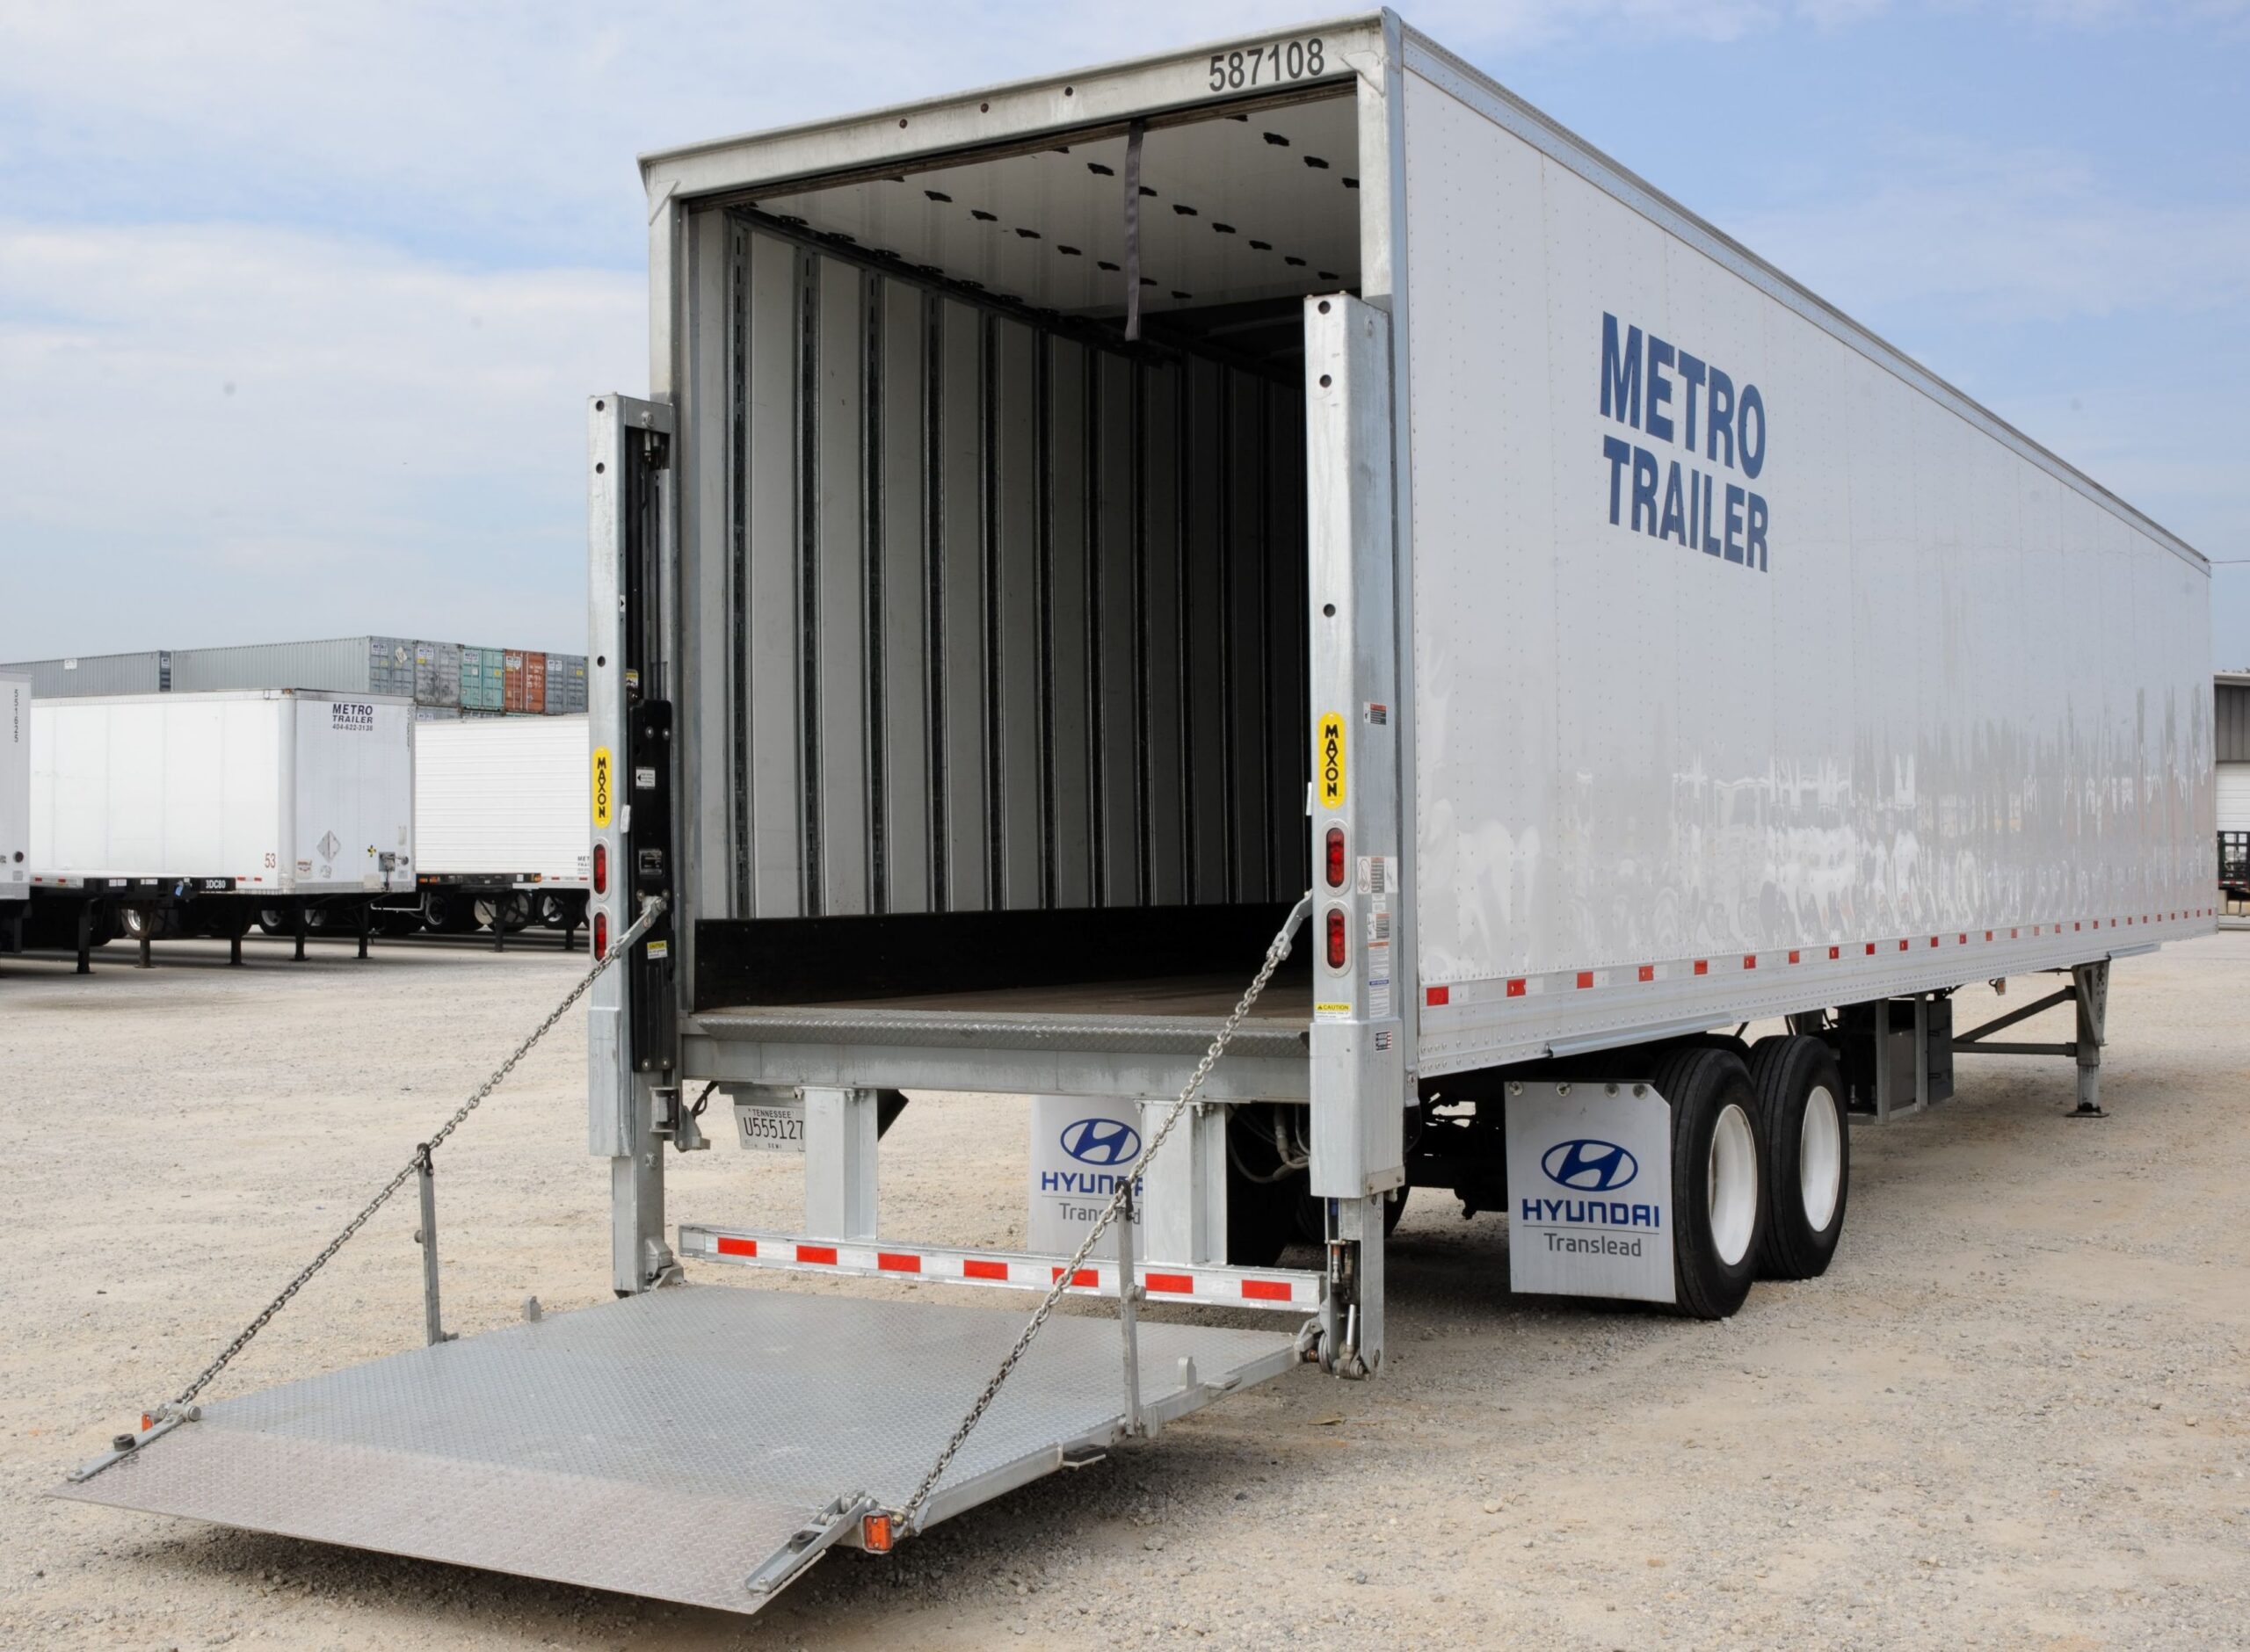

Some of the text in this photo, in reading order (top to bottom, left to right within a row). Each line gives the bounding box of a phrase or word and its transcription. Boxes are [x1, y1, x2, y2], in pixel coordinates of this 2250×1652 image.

[1209, 38, 1325, 92] 587108
[1600, 310, 1766, 480] METRO
[1603, 434, 1768, 573] TRAILER
[332, 704, 373, 715] METRO
[332, 715, 373, 724] TRAILER
[1325, 723, 1339, 797] MAXON
[597, 757, 606, 818] MAXON
[265, 852, 276, 868] 53
[752, 1109, 791, 1119] TENNESSEE
[744, 1117, 803, 1140] U555127
[1522, 1199, 1659, 1228] HYUNDAI
[1543, 1233, 1642, 1257] Translead
